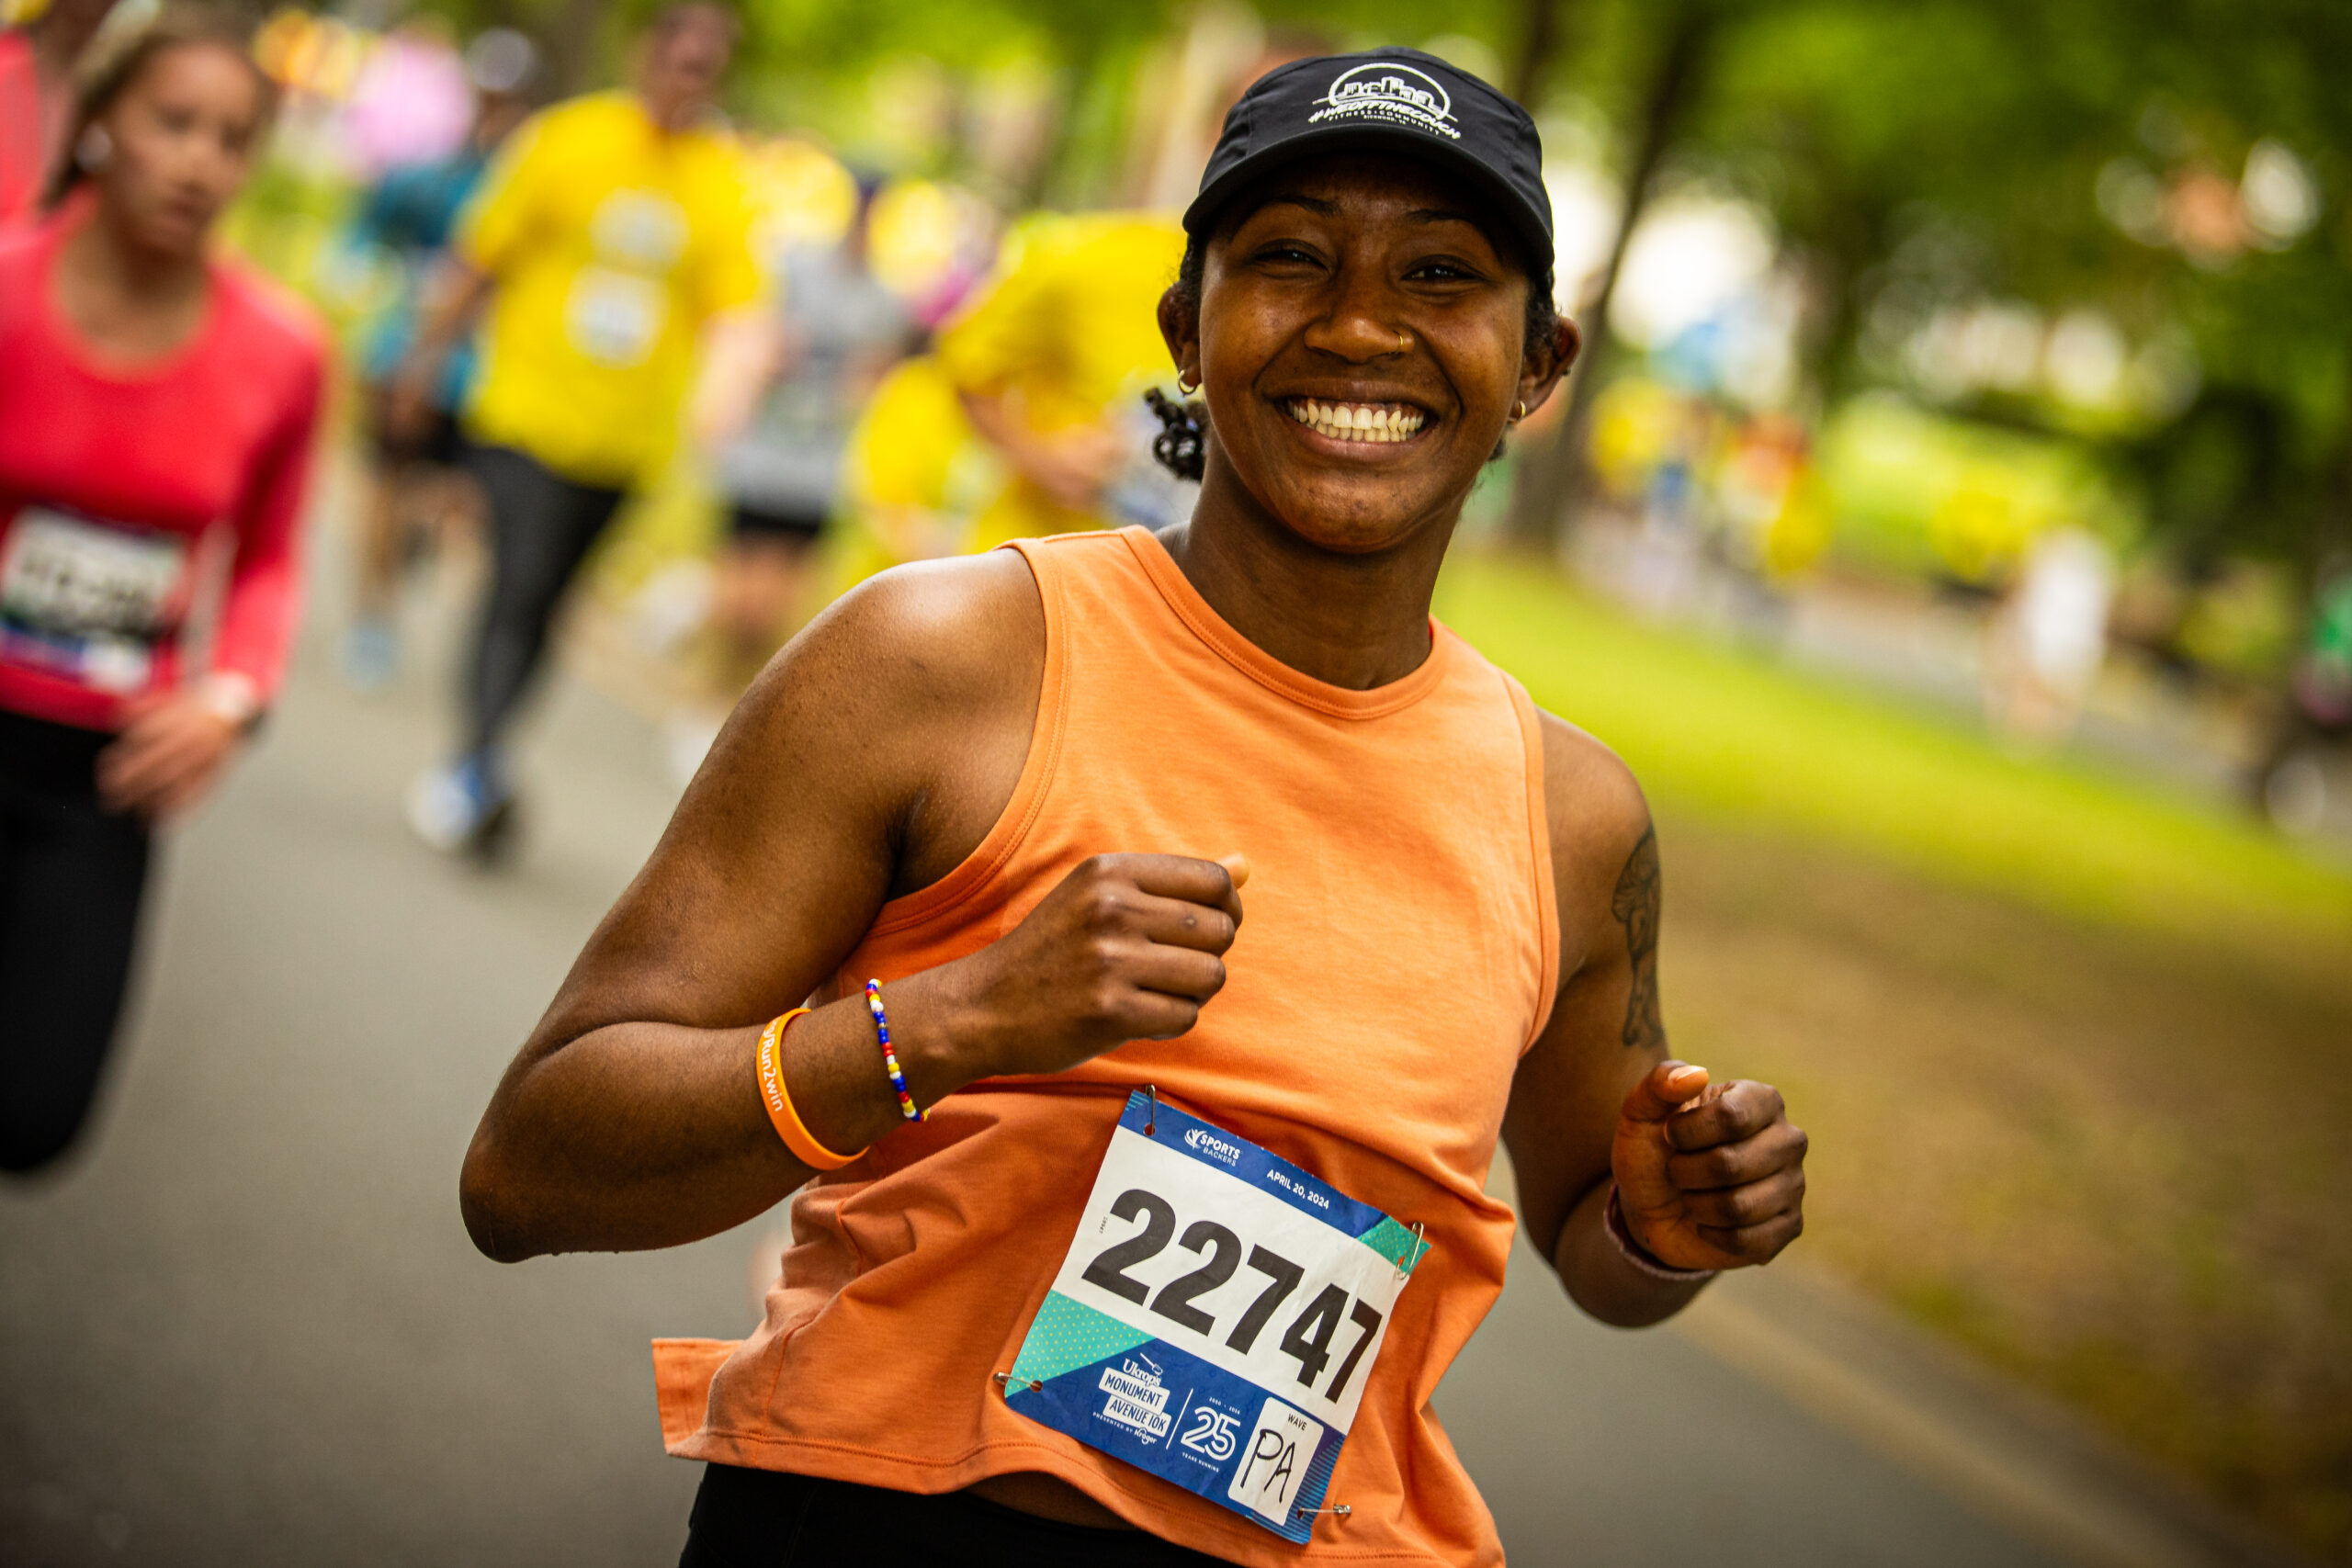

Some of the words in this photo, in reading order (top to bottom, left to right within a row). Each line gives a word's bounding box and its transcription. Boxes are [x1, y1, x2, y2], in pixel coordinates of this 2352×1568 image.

[1200, 1134, 1240, 1160] SPORTS
[1203, 1146, 1237, 1167] BACKERS
[1266, 1168, 1291, 1190] APRIL
[1293, 1182, 1306, 1200] 20,
[1306, 1190, 1329, 1211] 2024
[1081, 1189, 1383, 1404] 22747
[1104, 1373, 1163, 1407] MONUMENT
[1092, 1411, 1125, 1429] PRESENTED
[1134, 1427, 1158, 1445] Kroger
[1109, 1399, 1149, 1425] AVENUE
[1148, 1415, 1167, 1432] 10K
[1287, 1413, 1307, 1432] WAVE
[1180, 1405, 1241, 1461] 25
[1239, 1427, 1295, 1504] PA
